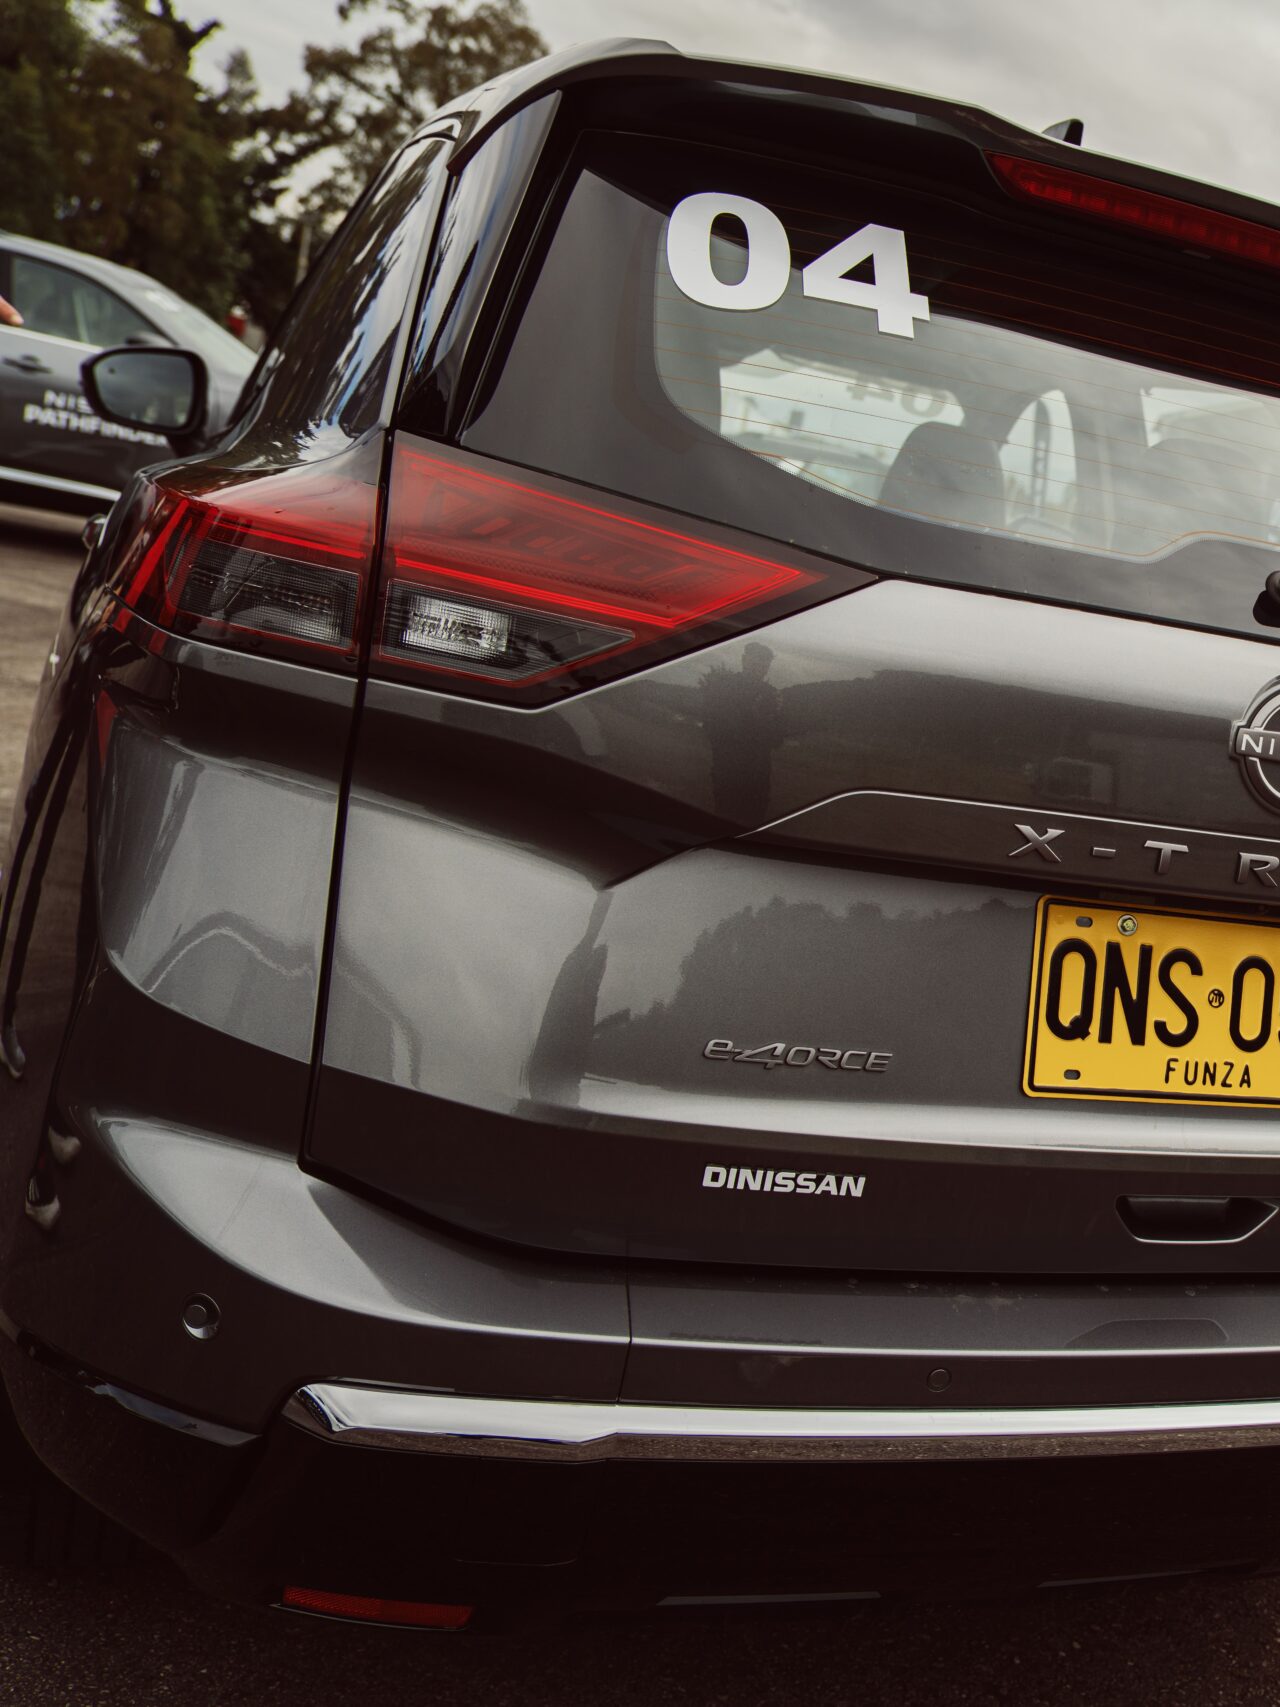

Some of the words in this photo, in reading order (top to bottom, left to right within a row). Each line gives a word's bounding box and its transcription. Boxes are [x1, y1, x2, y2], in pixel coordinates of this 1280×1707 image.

[666, 191, 931, 339] 04
[43, 389, 95, 415] NIS
[1164, 1057, 1253, 1089] FUNZA
[702, 1165, 866, 1198] DINISSAN
